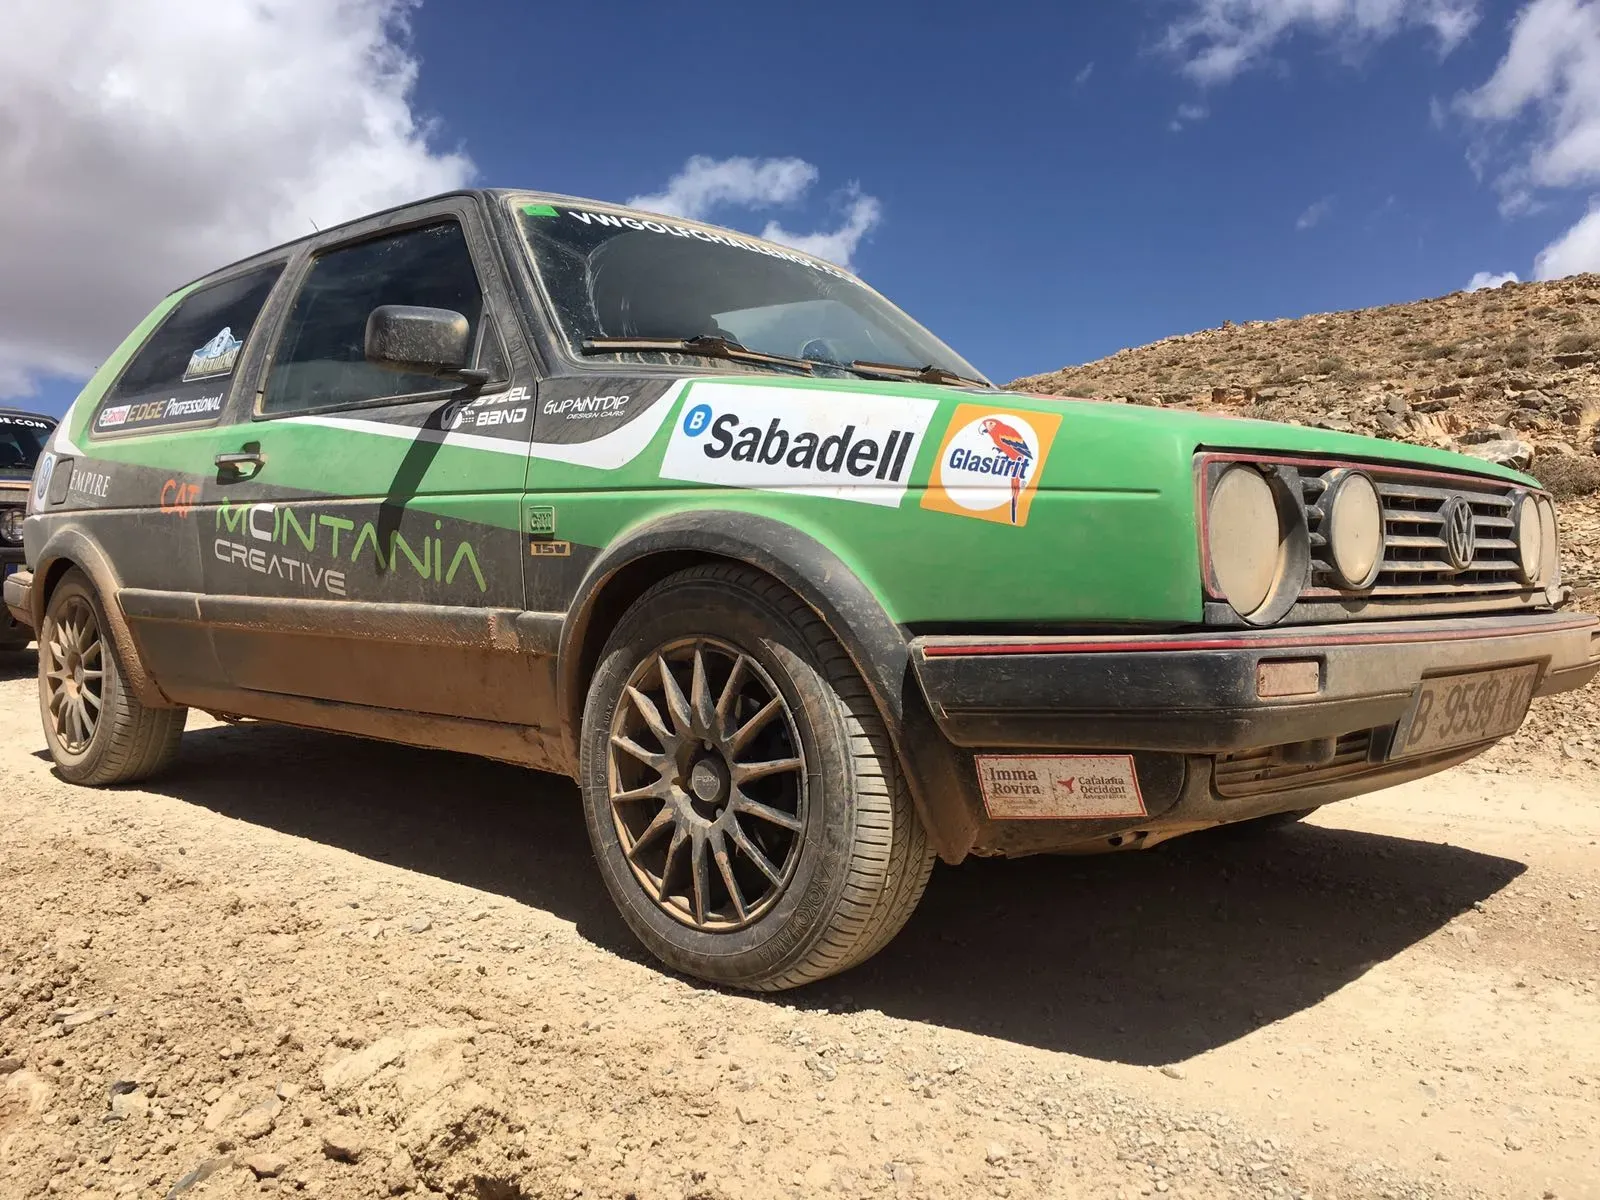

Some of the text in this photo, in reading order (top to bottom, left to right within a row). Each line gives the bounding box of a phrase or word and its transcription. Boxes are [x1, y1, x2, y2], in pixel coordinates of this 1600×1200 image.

[127, 400, 167, 422] EDGE
[566, 410, 625, 420] DESIGN CARS
[703, 413, 915, 483] Sabadell
[949, 448, 1030, 480] Glasurit
[69, 469, 111, 498] EMPIRE
[160, 479, 200, 519] CAT
[214, 538, 347, 597] CREATIVE
[989, 767, 1038, 781] Imma
[991, 782, 1041, 795] Rovira
[1080, 785, 1126, 794] Occident
